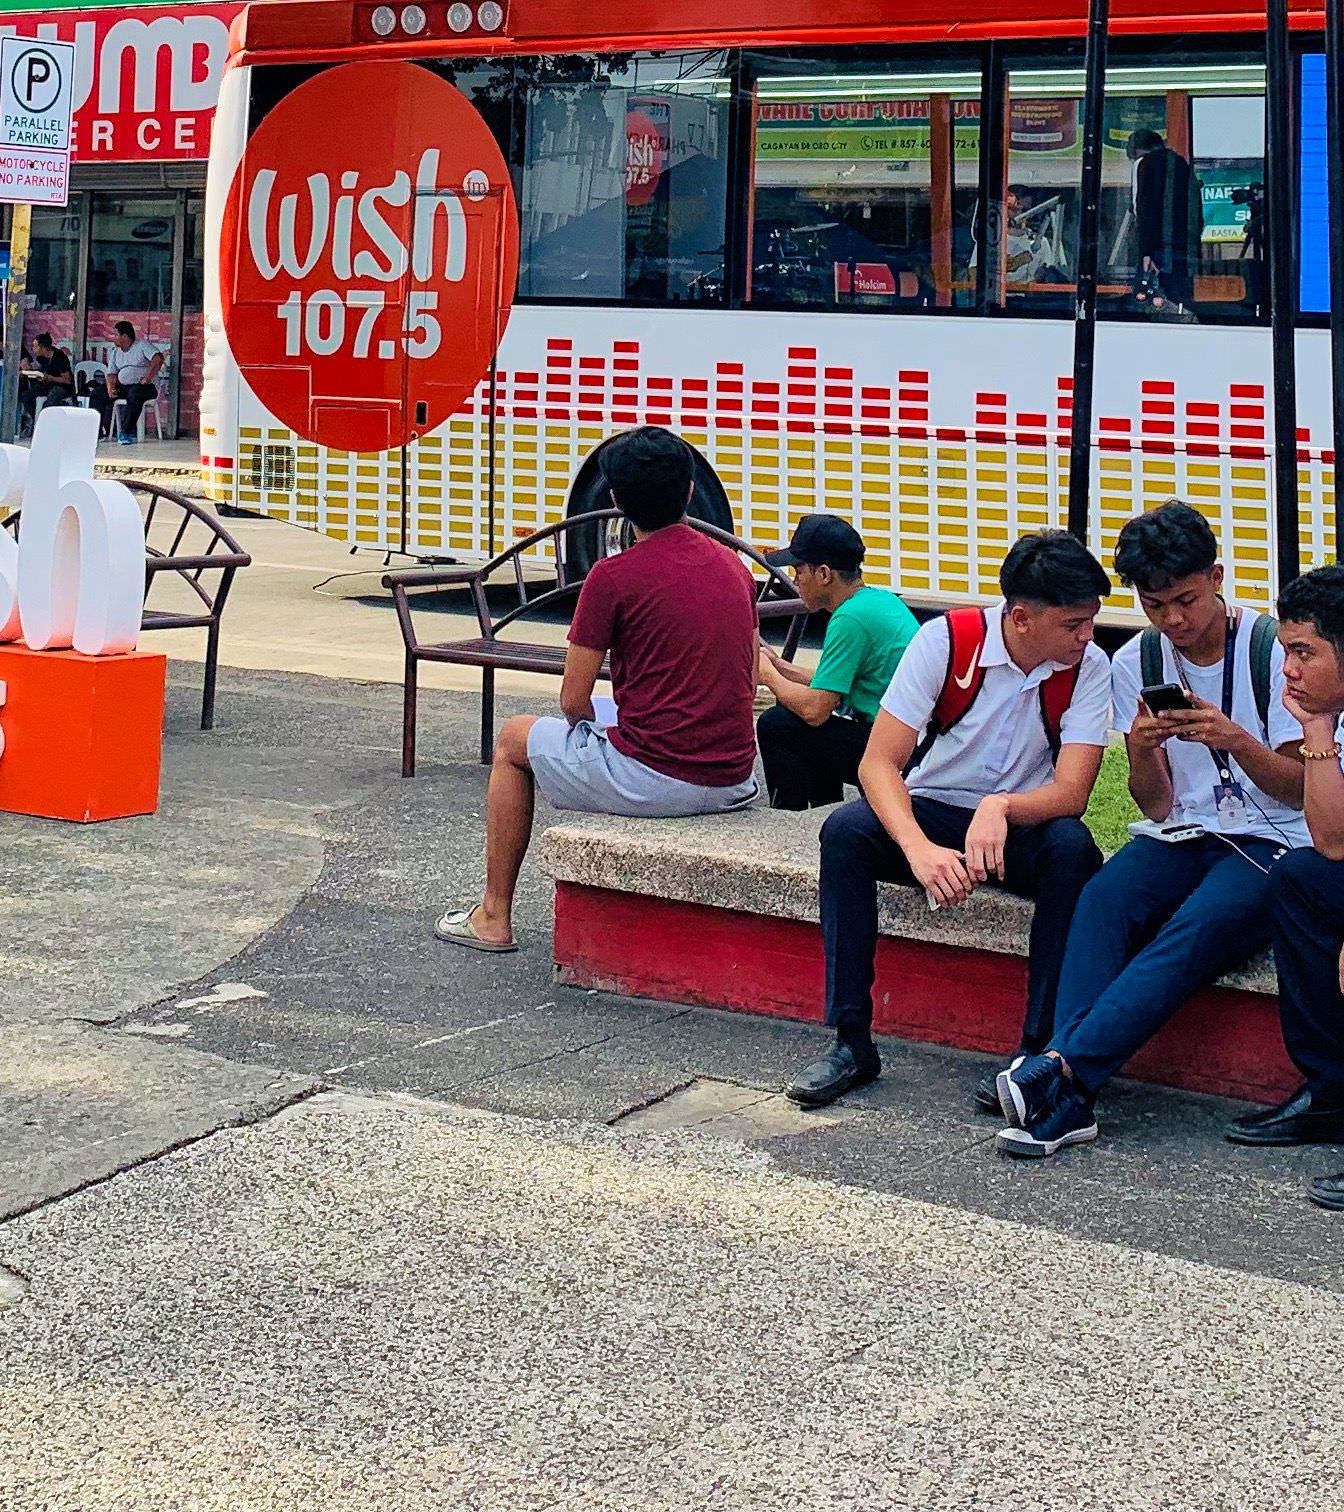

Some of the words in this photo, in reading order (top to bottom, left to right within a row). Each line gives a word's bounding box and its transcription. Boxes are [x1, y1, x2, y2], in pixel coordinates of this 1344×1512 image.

[26, 57, 51, 102] P
[4, 115, 64, 132] PARALLEL
[8, 129, 59, 146] PARKING
[16, 174, 64, 188] PARKING
[858, 279, 887, 290] Holcim
[277, 289, 442, 360] 107.5
